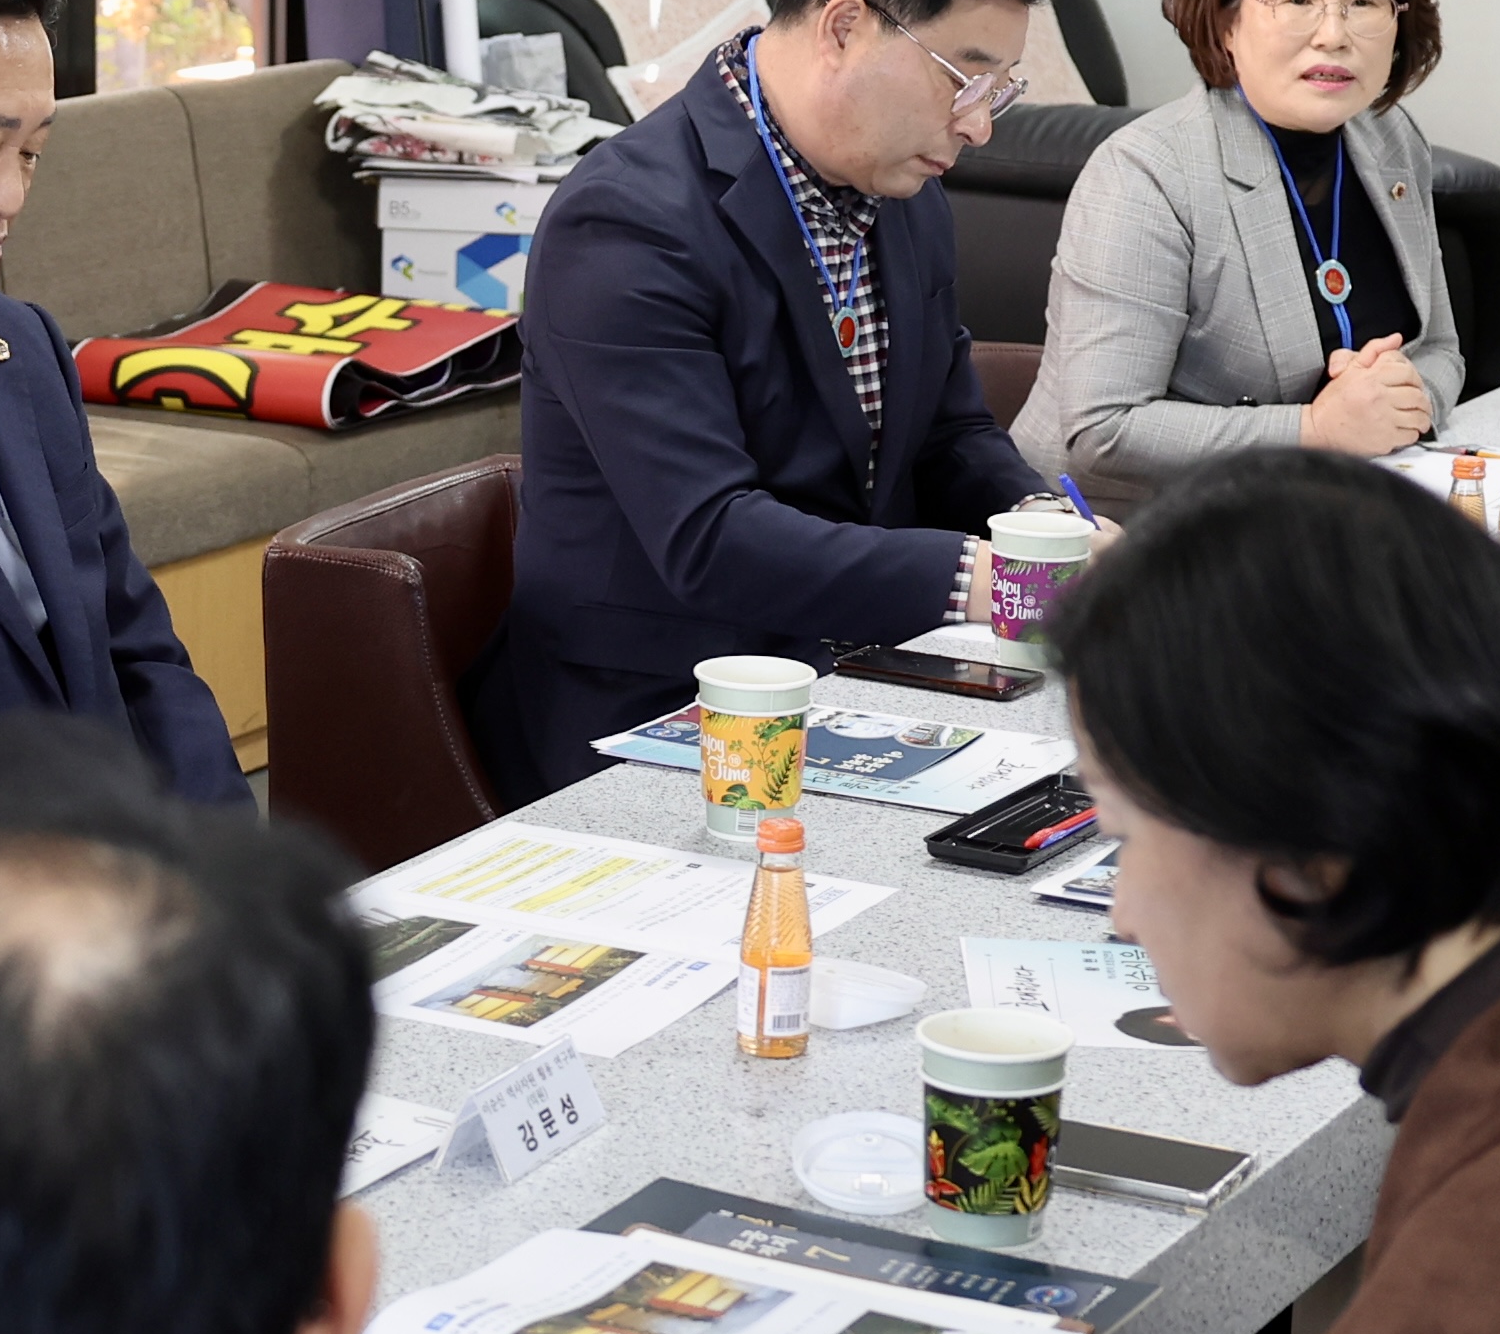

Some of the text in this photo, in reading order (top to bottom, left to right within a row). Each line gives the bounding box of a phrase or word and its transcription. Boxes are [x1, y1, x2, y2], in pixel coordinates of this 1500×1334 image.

[389, 200, 410, 216] B5
[1003, 597, 1044, 621] Time
[700, 732, 725, 763] njoy
[708, 755, 752, 783] Time
